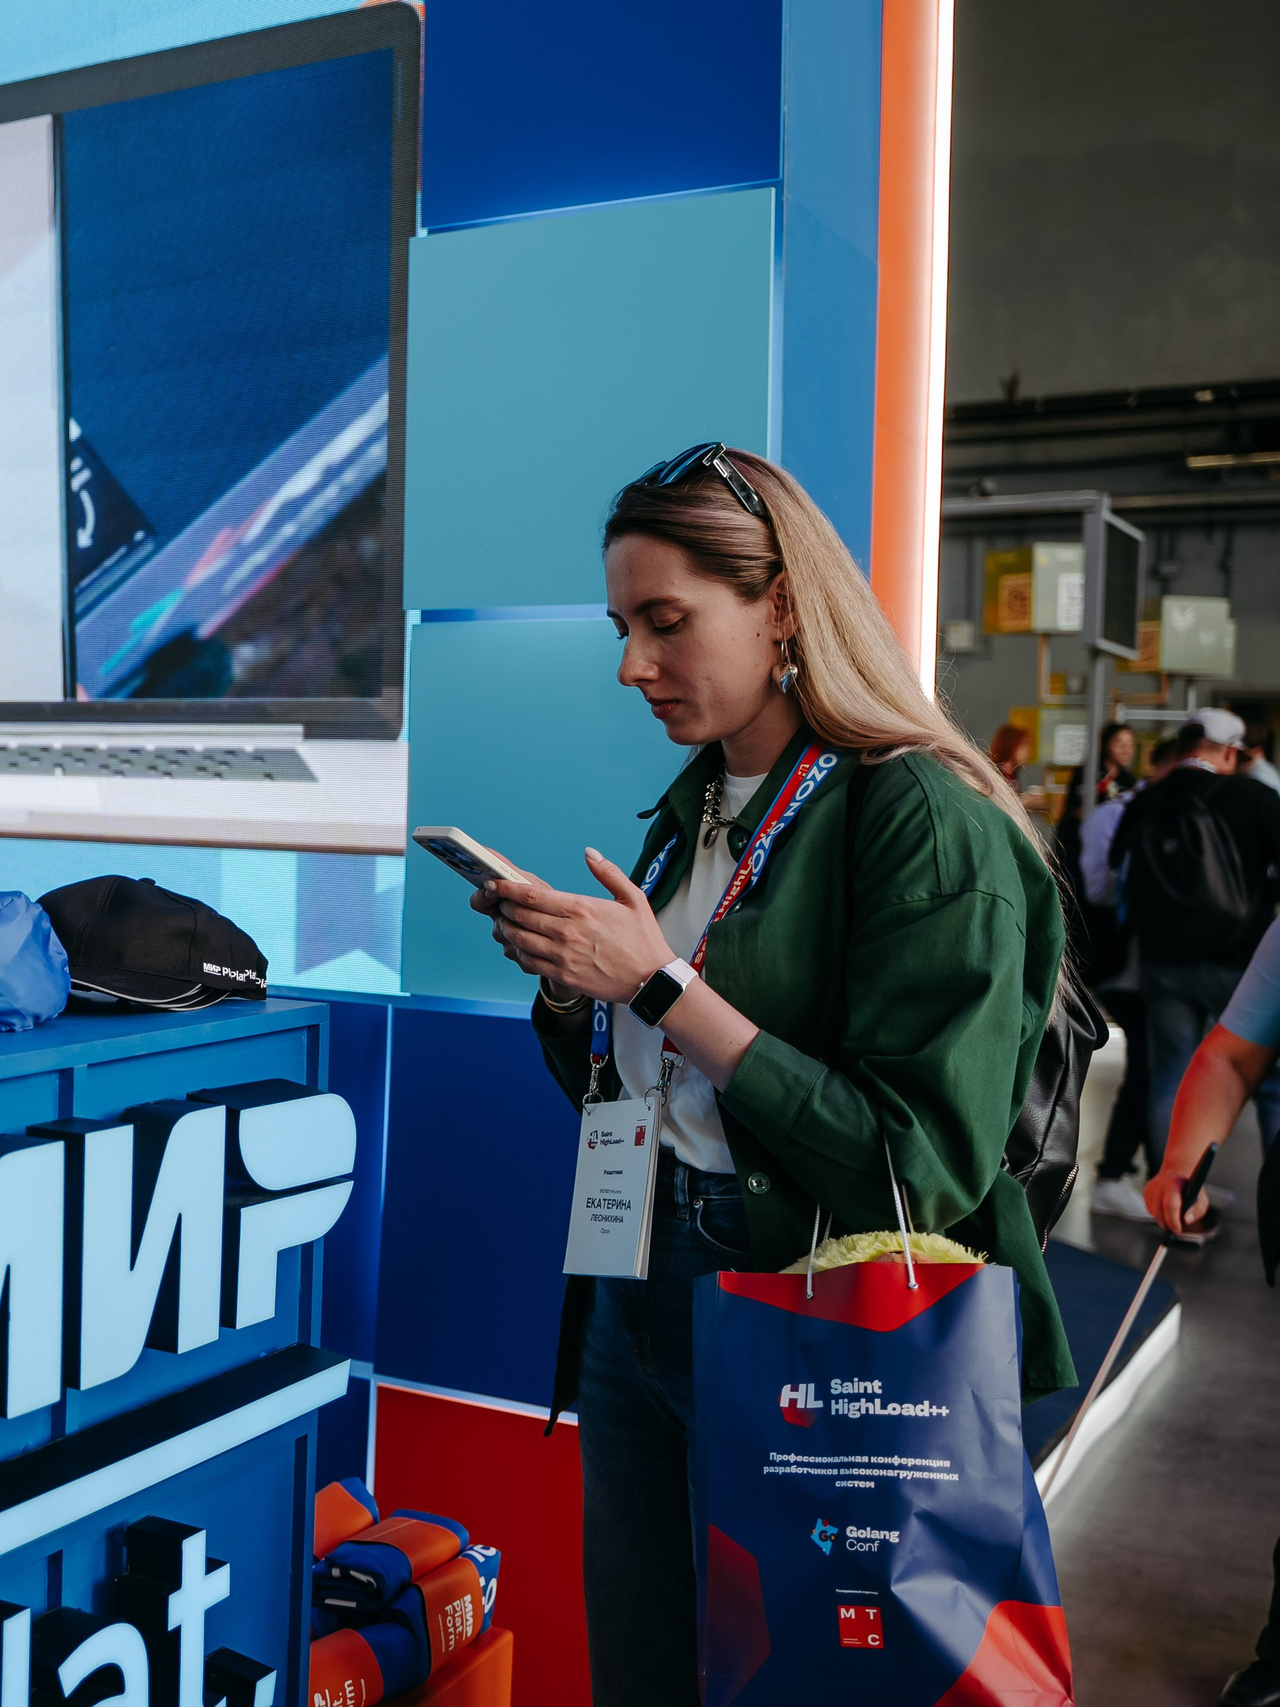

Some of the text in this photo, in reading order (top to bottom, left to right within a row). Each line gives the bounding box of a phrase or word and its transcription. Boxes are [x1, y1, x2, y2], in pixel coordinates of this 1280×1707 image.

[586, 1197, 632, 1211] ЕКАТЕРИНА
[779, 1377, 883, 1409] HL Saint
[830, 1398, 950, 1419] HighLoad++
[769, 1452, 951, 1468] Профессиональная конференция
[763, 1465, 959, 1481] разработчиков высоконагруженных
[835, 1480, 875, 1489] систем
[845, 1525, 900, 1543] Golang
[845, 1539, 880, 1552] Conf
[444, 1603, 455, 1651] Form
